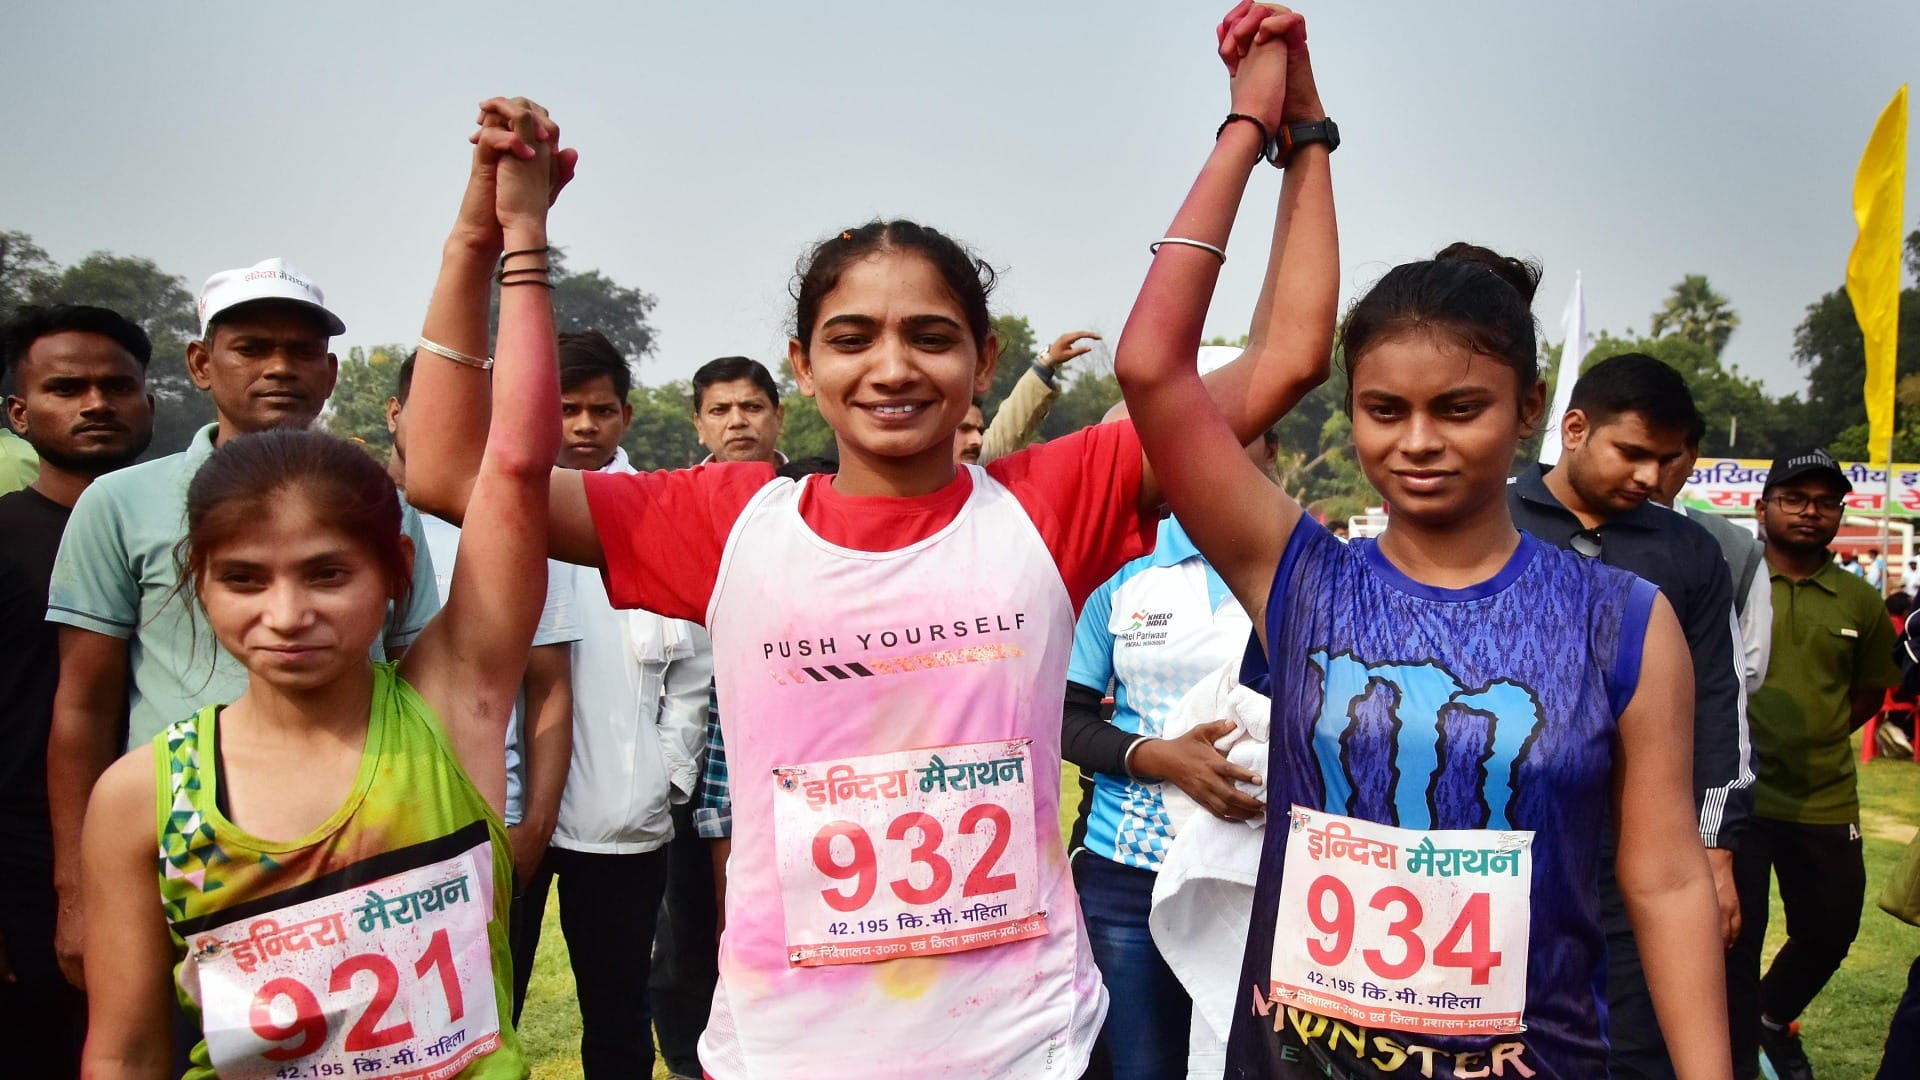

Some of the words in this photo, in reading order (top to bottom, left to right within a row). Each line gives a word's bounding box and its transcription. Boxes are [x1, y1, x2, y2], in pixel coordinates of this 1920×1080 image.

[763, 637, 837, 660] PUSH
[856, 613, 1025, 651] YOURSELF
[1145, 619, 1168, 627] INDIA
[1147, 612, 1173, 621] KHELO
[801, 765, 908, 811] इन्दिरा
[915, 754, 1025, 793] मैराथन
[811, 803, 1017, 912] 932
[1307, 822, 1398, 870] इन्दिरा
[1406, 837, 1521, 877] मैराथन
[231, 912, 347, 974] इन्दिरा
[352, 874, 471, 933] मैराथन
[828, 919, 889, 936] 42.195
[931, 936, 958, 950] जिला
[1306, 874, 1502, 985] 934
[249, 927, 465, 1061] 921
[1307, 971, 1355, 994] 42.195
[1252, 984, 1536, 1079] MONSTER
[1390, 1012, 1418, 1025] जिला
[276, 1063, 344, 1080] 42.195
